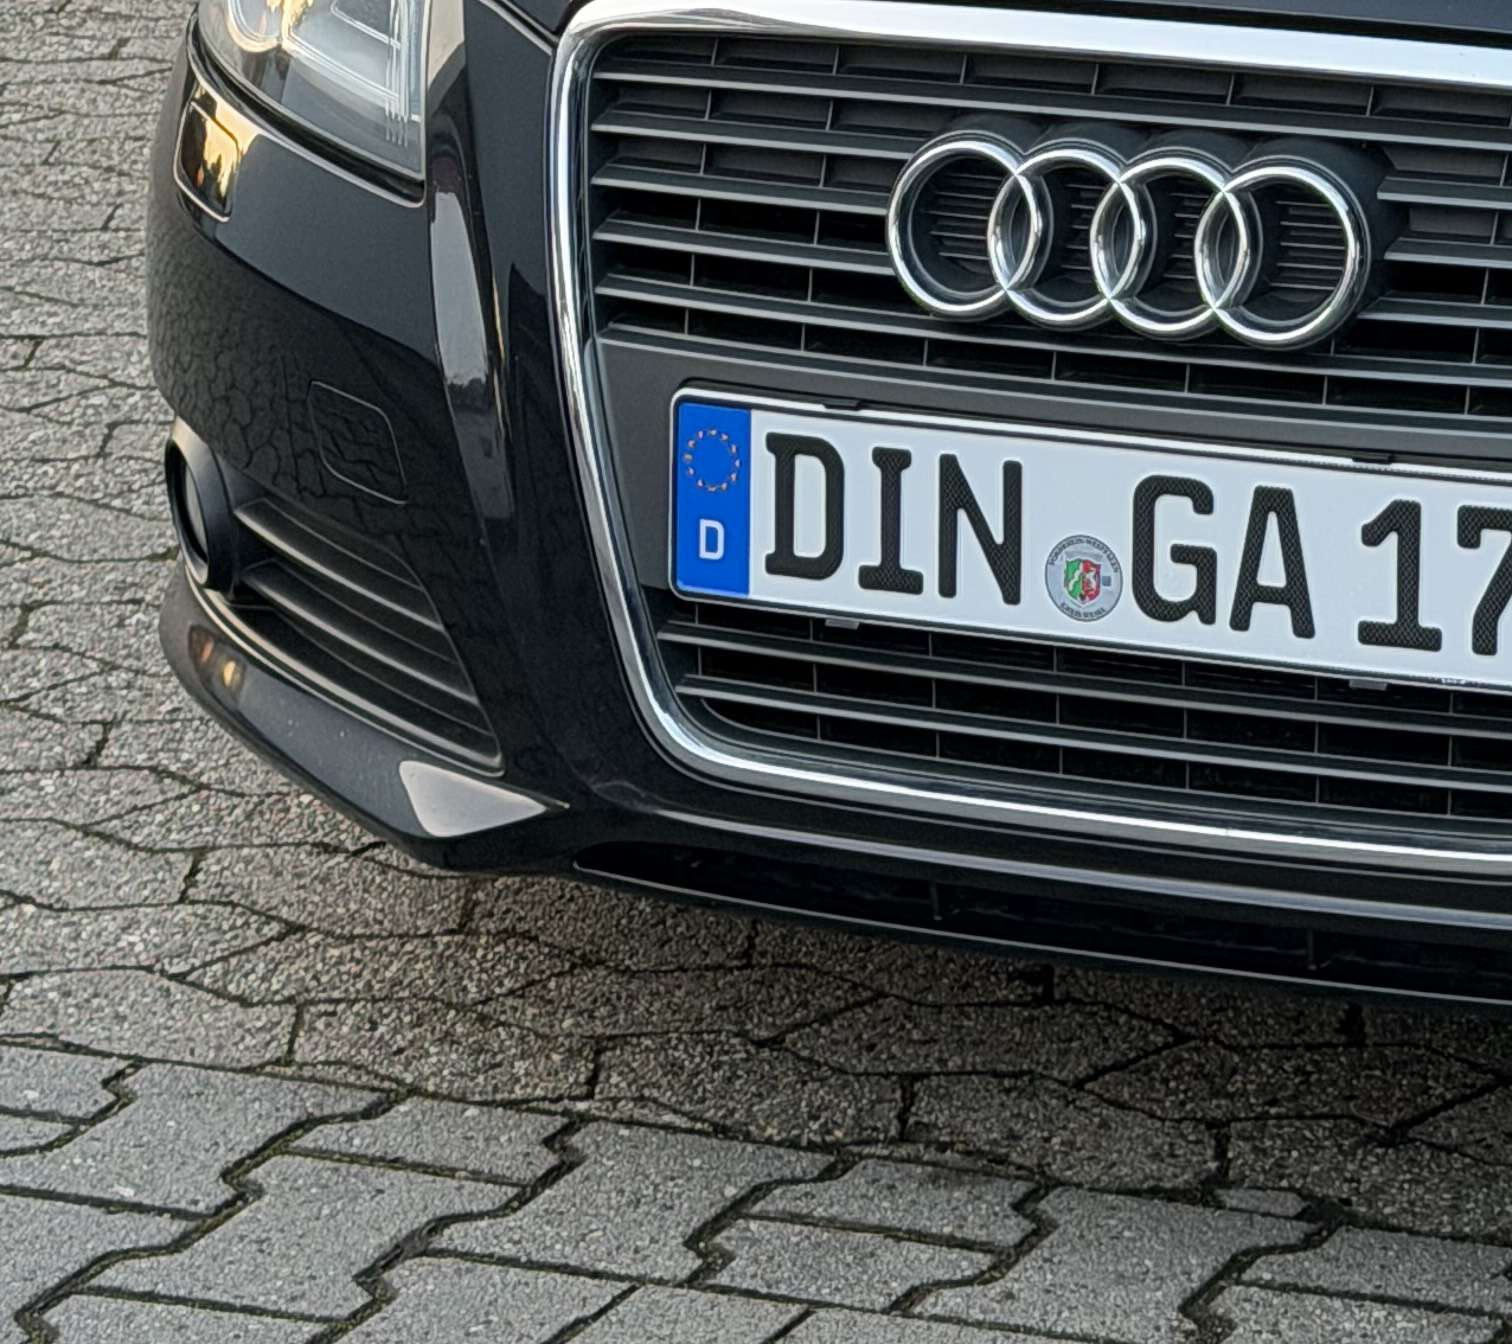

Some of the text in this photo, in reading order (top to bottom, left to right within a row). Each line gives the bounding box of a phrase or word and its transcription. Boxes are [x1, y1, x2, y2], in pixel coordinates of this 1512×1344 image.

[698, 518, 726, 561] D
[763, 431, 1023, 607] DIN
[1130, 474, 1316, 640] GA
